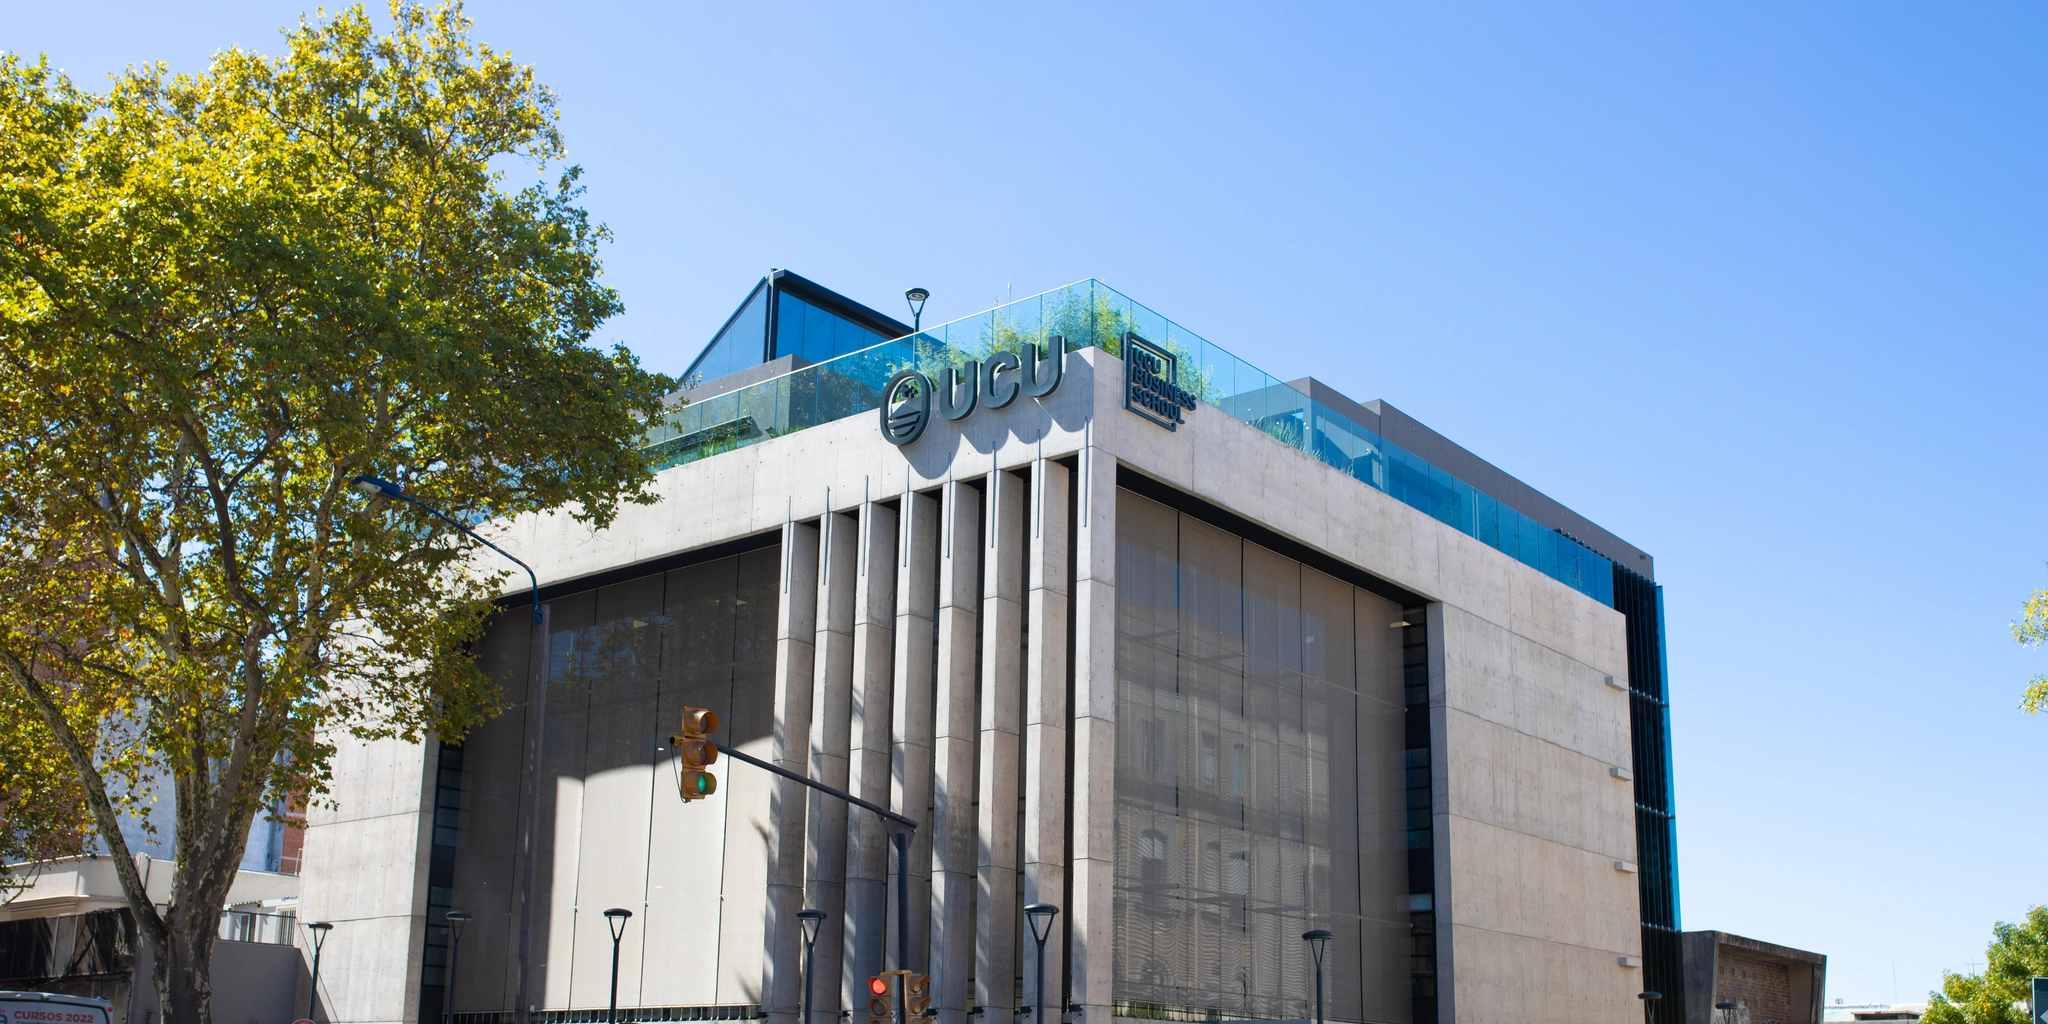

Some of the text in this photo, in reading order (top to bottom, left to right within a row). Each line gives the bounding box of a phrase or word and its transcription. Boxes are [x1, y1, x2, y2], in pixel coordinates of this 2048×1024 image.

[940, 335, 1066, 421] UCU
[1132, 348, 1161, 374] UCU
[1132, 365, 1196, 411] BUSINESS
[1132, 386, 1185, 424] SCHOOL
[13, 1010, 63, 1021] CURSOS
[65, 1013, 94, 1023] 2022
